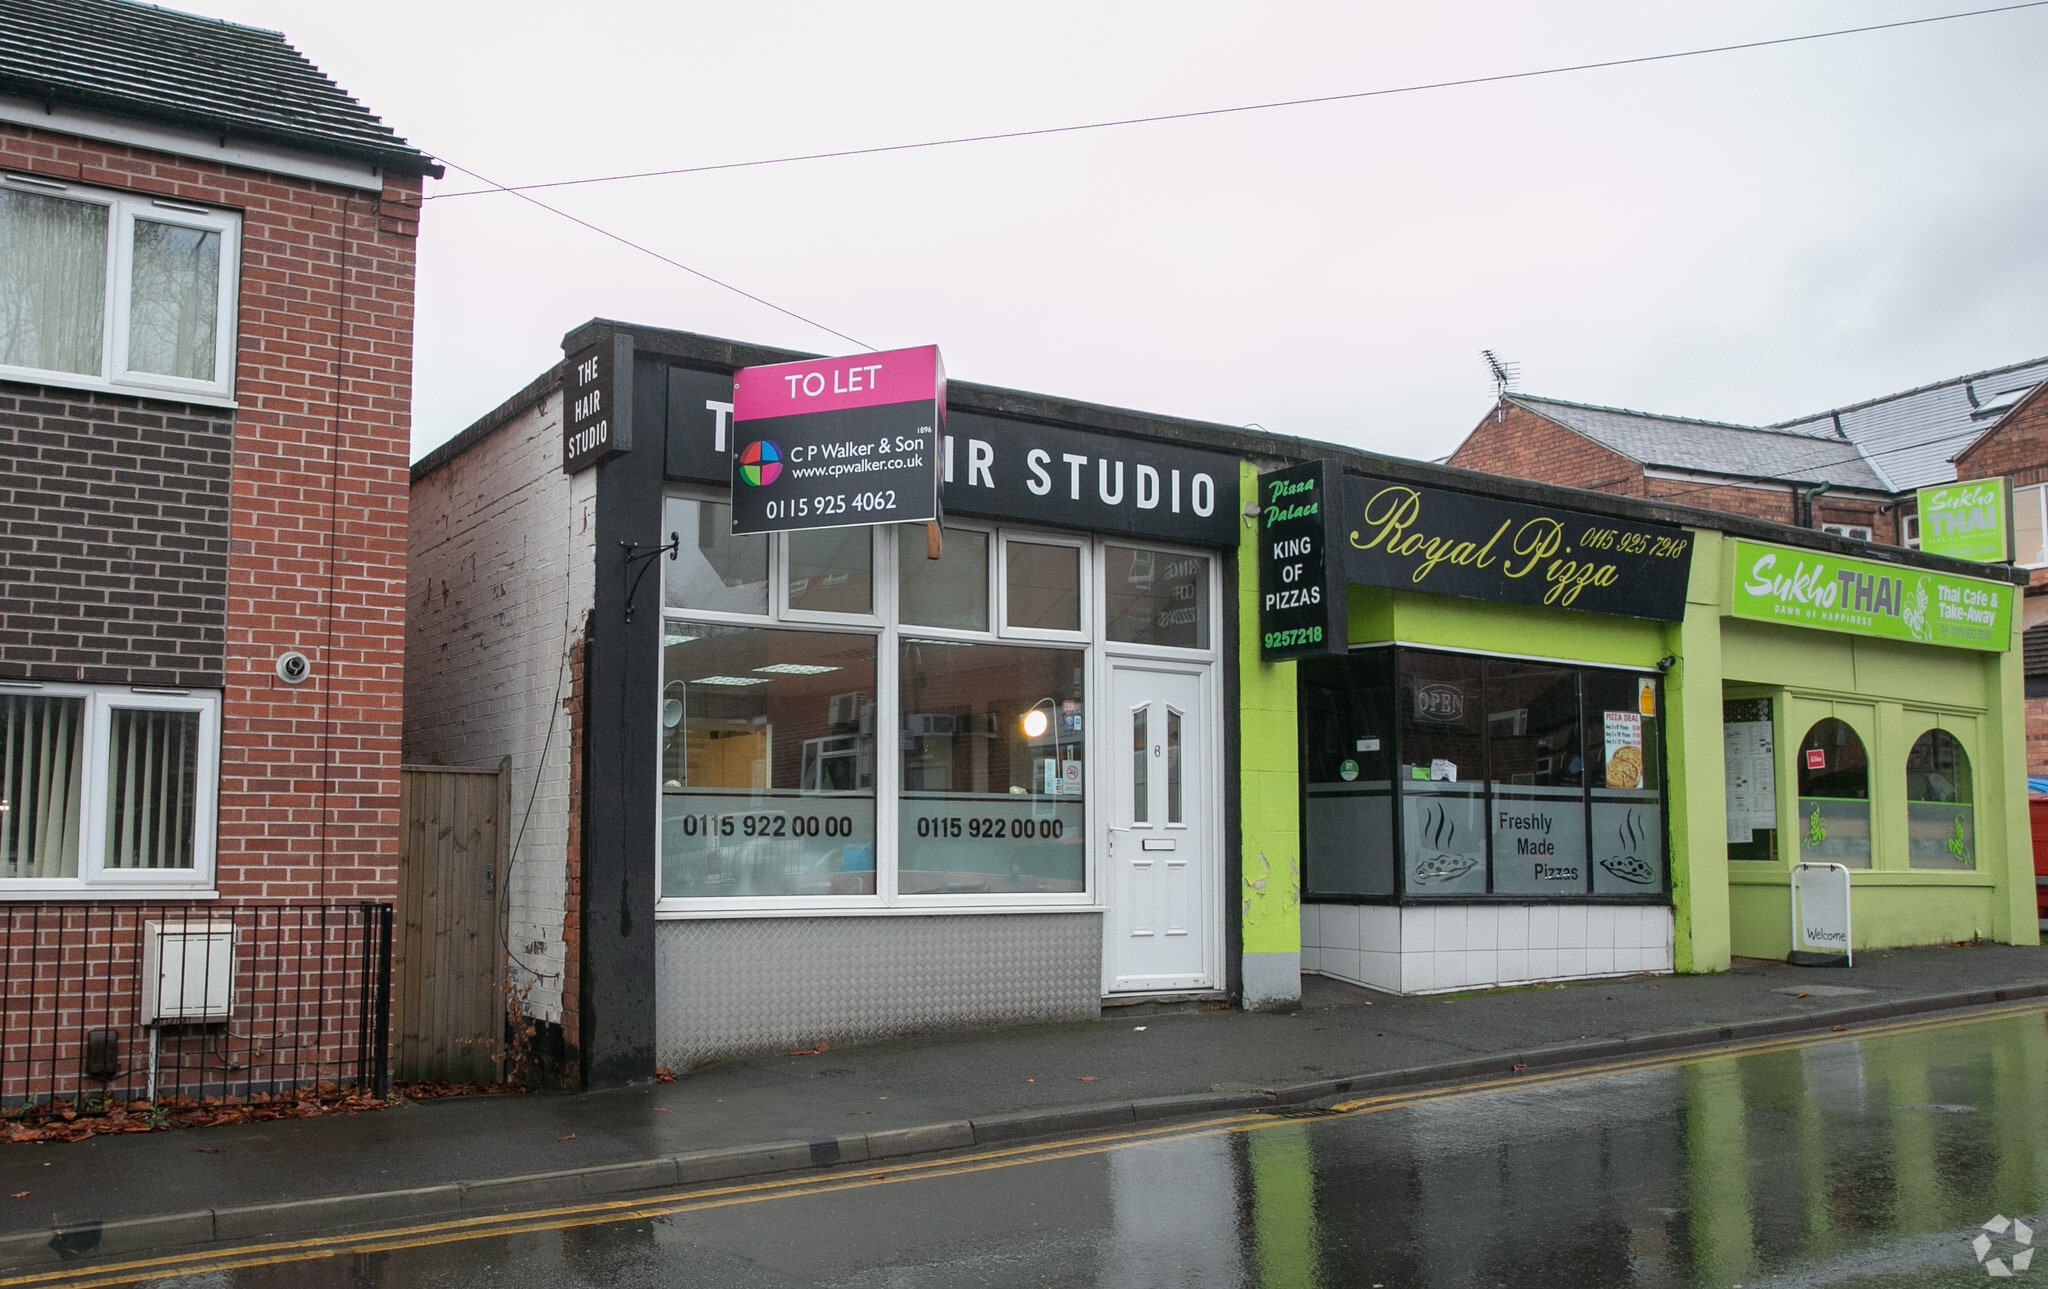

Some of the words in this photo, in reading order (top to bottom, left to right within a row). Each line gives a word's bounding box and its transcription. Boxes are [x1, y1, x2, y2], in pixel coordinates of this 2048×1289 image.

[578, 356, 598, 387] THE
[785, 372, 825, 398] TO
[834, 365, 882, 394] LET
[575, 390, 600, 422] HAIR
[568, 420, 607, 459] STUDIO
[917, 426, 932, 434] 1896
[790, 447, 803, 462] C
[808, 446, 817, 461] P
[821, 442, 874, 459] Walker
[879, 438, 891, 453] &
[895, 436, 924, 452] Son
[792, 454, 923, 479] www.cpwalker.co.uk
[944, 435, 995, 489] IR
[1026, 448, 1214, 518] STUDIO
[1269, 478, 1314, 503] Pizza
[1927, 486, 1994, 511] Sukho
[766, 498, 808, 519] 0115
[814, 494, 846, 515] 925
[851, 490, 897, 512] 4062
[1264, 502, 1318, 528] Palace
[1927, 505, 1995, 536] THAI
[1273, 536, 1311, 560] KING
[1350, 486, 1512, 583] Royal
[1504, 517, 1619, 607] Pizza
[1580, 527, 1618, 550] 0115
[1616, 532, 1651, 554] 925
[1648, 536, 1687, 558] 7218
[1283, 563, 1303, 583] OF
[1265, 586, 1320, 611] PIZZAS
[1938, 585, 1960, 603] Thai
[1963, 588, 1987, 607] Cafe
[1990, 592, 1998, 608] &
[1774, 604, 1800, 617] DAWN
[1821, 611, 1872, 626] HAPPINESS
[1939, 602, 1996, 627] Take-Away
[1264, 626, 1323, 649] 9257218
[1418, 692, 1463, 713] OPEN
[1154, 744, 1161, 758] 6
[683, 814, 734, 836] 0115
[743, 815, 786, 837] 922
[917, 817, 962, 838] 0115
[968, 818, 1006, 839] 922
[1499, 812, 1552, 835] Freshly
[1517, 838, 1555, 856] Made
[1534, 863, 1579, 881] Pizzas
[1807, 927, 1846, 942] Welcome
